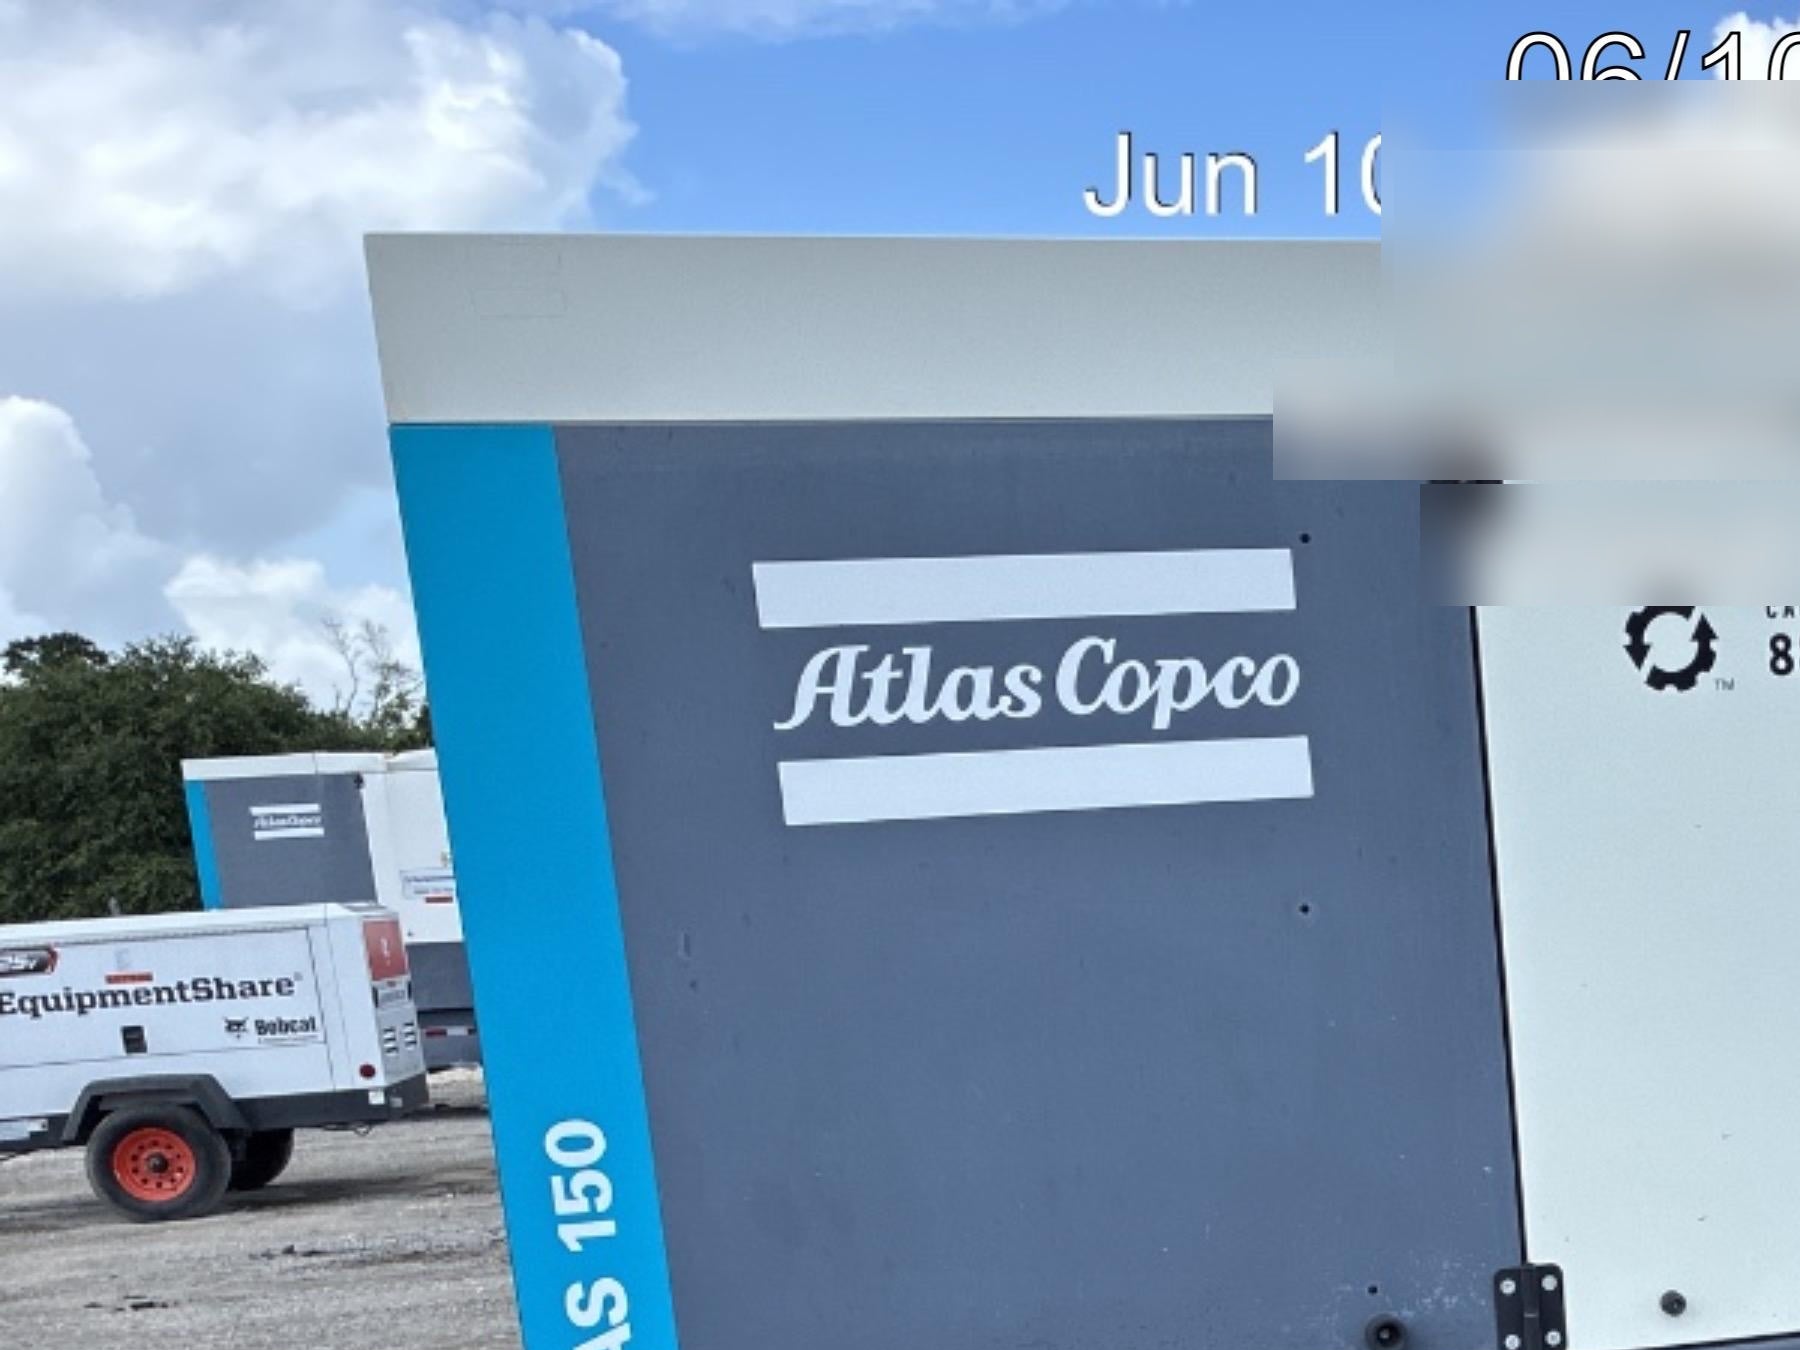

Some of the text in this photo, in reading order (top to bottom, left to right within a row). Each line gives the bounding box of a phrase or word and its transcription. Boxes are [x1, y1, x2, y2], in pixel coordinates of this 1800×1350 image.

[774, 636, 1300, 729] Atlas Copco
[0, 976, 295, 1019] EquipmentShare
[255, 1016, 317, 1037] Bobcat
[544, 1118, 616, 1252] 150
